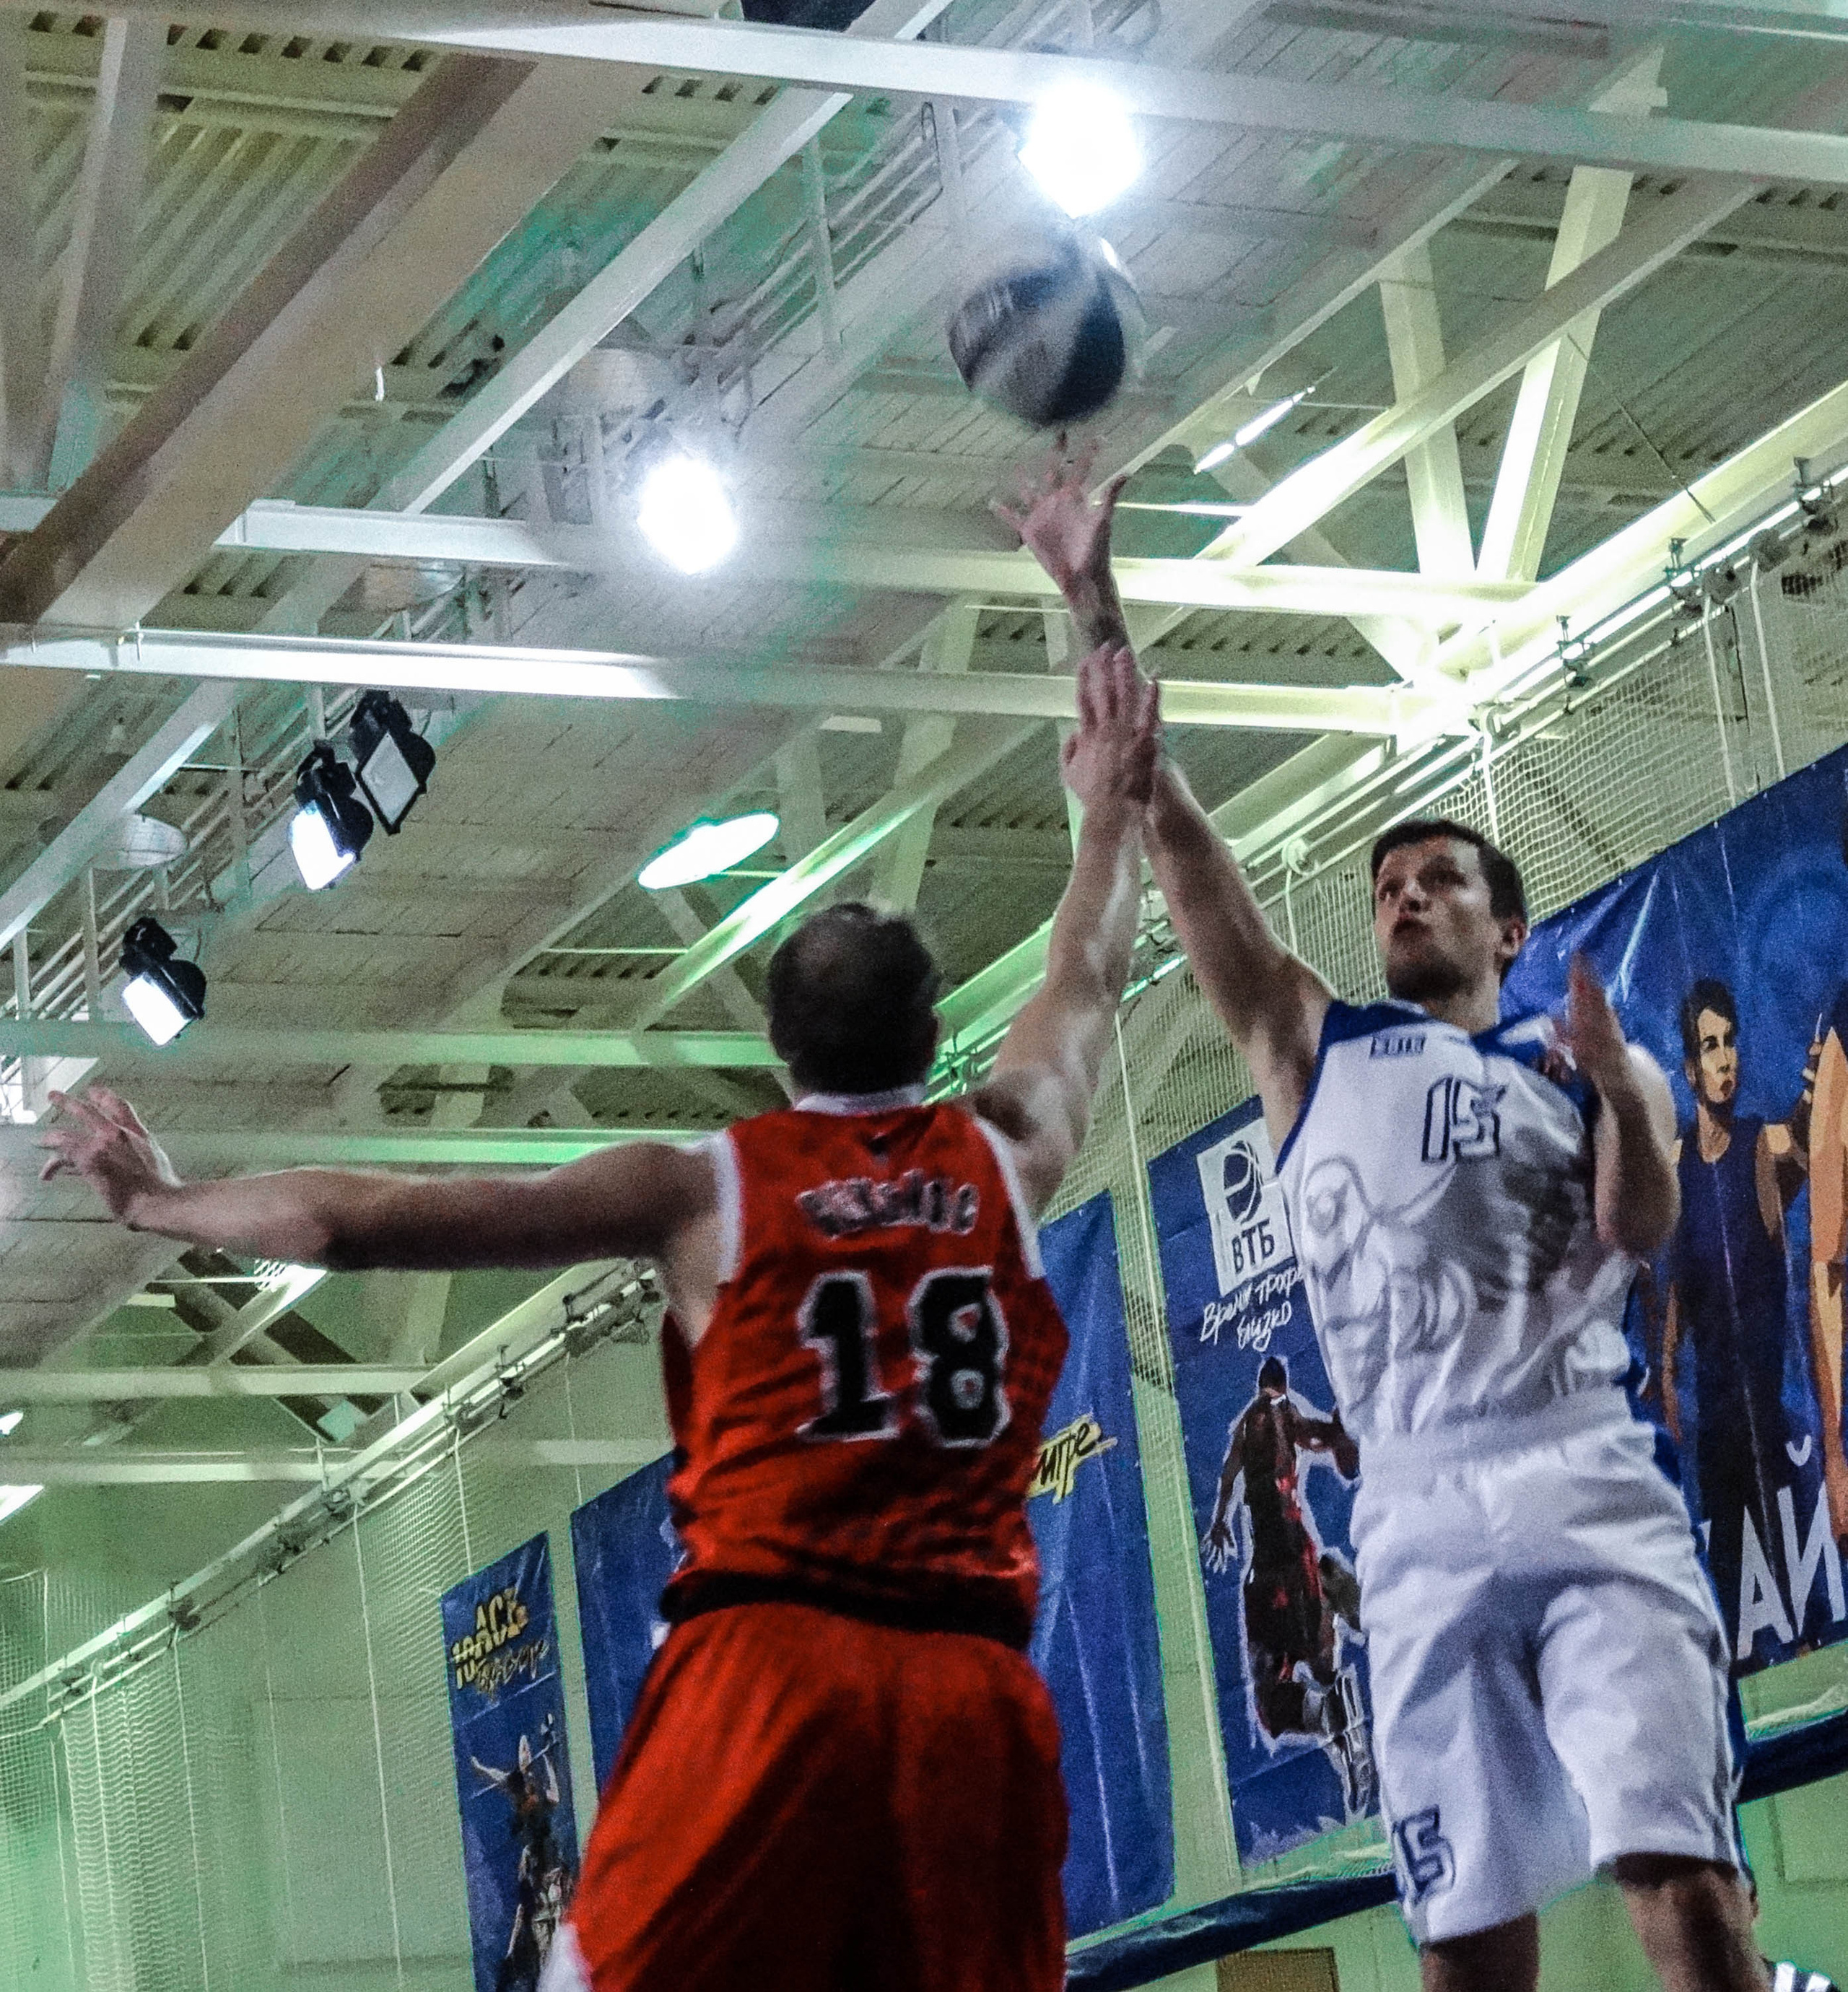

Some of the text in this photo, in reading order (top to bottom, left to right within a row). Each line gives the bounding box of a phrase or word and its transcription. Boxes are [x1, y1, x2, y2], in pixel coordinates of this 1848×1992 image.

[1420, 1074, 1507, 1163] 15
[1231, 1217, 1275, 1275] ВТБ
[795, 1265, 1012, 1449] 18
